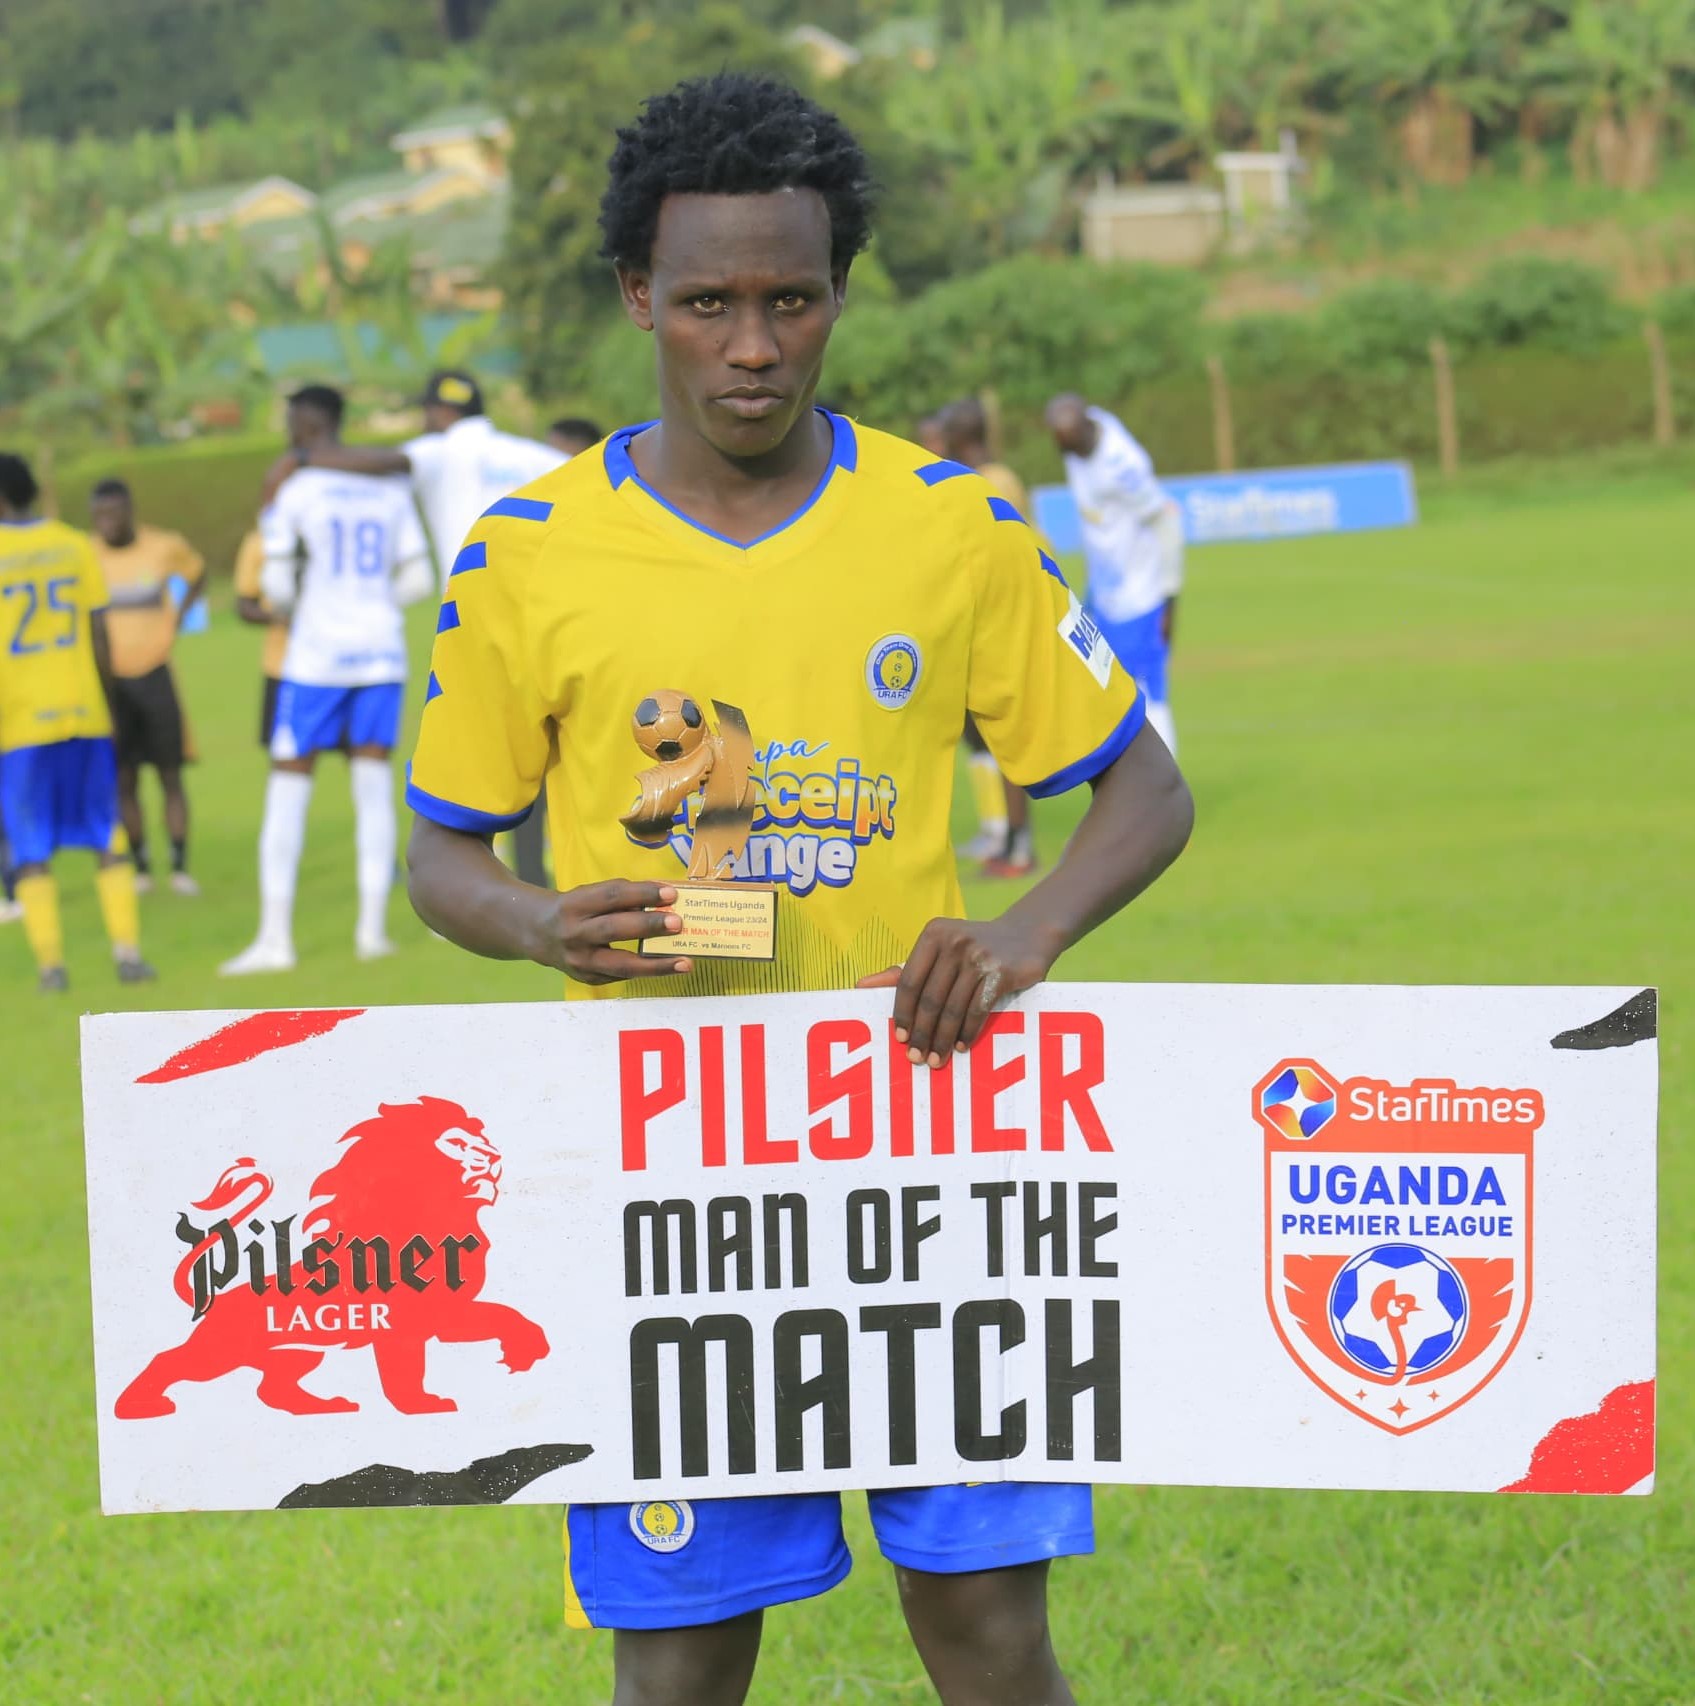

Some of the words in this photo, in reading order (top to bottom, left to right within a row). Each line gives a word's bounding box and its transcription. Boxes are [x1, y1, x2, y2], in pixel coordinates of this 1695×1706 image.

[330, 516, 386, 578] 18
[2, 574, 80, 656] 25
[878, 691, 897, 699] URA
[683, 913, 713, 922] Premier
[715, 914, 745, 924] League
[684, 898, 729, 908] StarTimes
[730, 900, 766, 910] Uganda
[672, 940, 688, 948] URA
[690, 928, 709, 936] MAN
[710, 928, 722, 936] OF
[723, 929, 741, 937] THE
[740, 930, 770, 938] MATCH
[619, 1011, 1114, 1171] PILSNER
[1349, 1086, 1535, 1123] StarTimes
[1289, 1164, 1507, 1206] UGANDA
[623, 1193, 809, 1297] MAN
[846, 1185, 941, 1284] OF
[970, 1181, 1118, 1278] THE
[1281, 1214, 1400, 1235] PREMIER
[1408, 1215, 1513, 1237] LEAGUE
[175, 1211, 481, 1323] Pilsner
[266, 1303, 392, 1332] LAGER
[630, 1298, 1121, 1480] MATCH
[647, 1537, 667, 1545] URA
